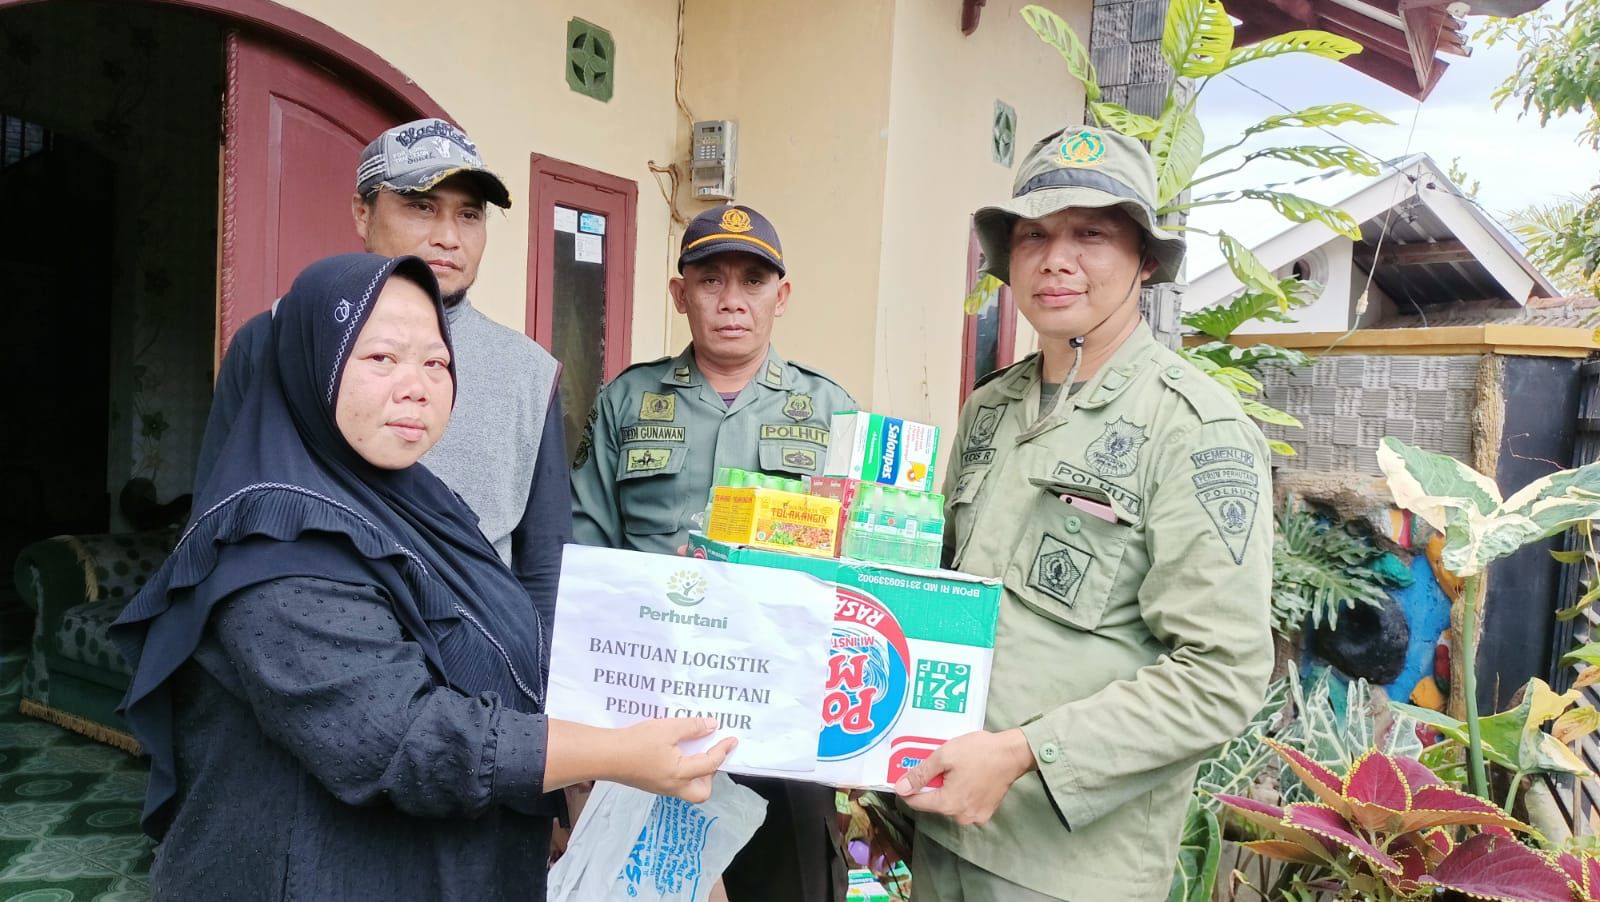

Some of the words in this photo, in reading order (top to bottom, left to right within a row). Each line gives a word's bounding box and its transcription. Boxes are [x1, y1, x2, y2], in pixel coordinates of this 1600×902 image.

[640, 426, 683, 440] GUNAWAN
[765, 426, 828, 444] POLHUT
[881, 422, 900, 480] Salonpas
[1203, 487, 1254, 501] POLHUT
[922, 583, 939, 593] MD
[940, 585, 950, 594] RI
[951, 586, 981, 598] BPOM
[639, 605, 728, 630] Perhutani
[589, 637, 678, 665] BANTUAN
[681, 651, 770, 674] LOGISTIK
[919, 661, 968, 675] CUP
[592, 667, 656, 693] PERUM
[660, 679, 771, 705] PERHUTANI
[605, 696, 669, 720] PEDULI
